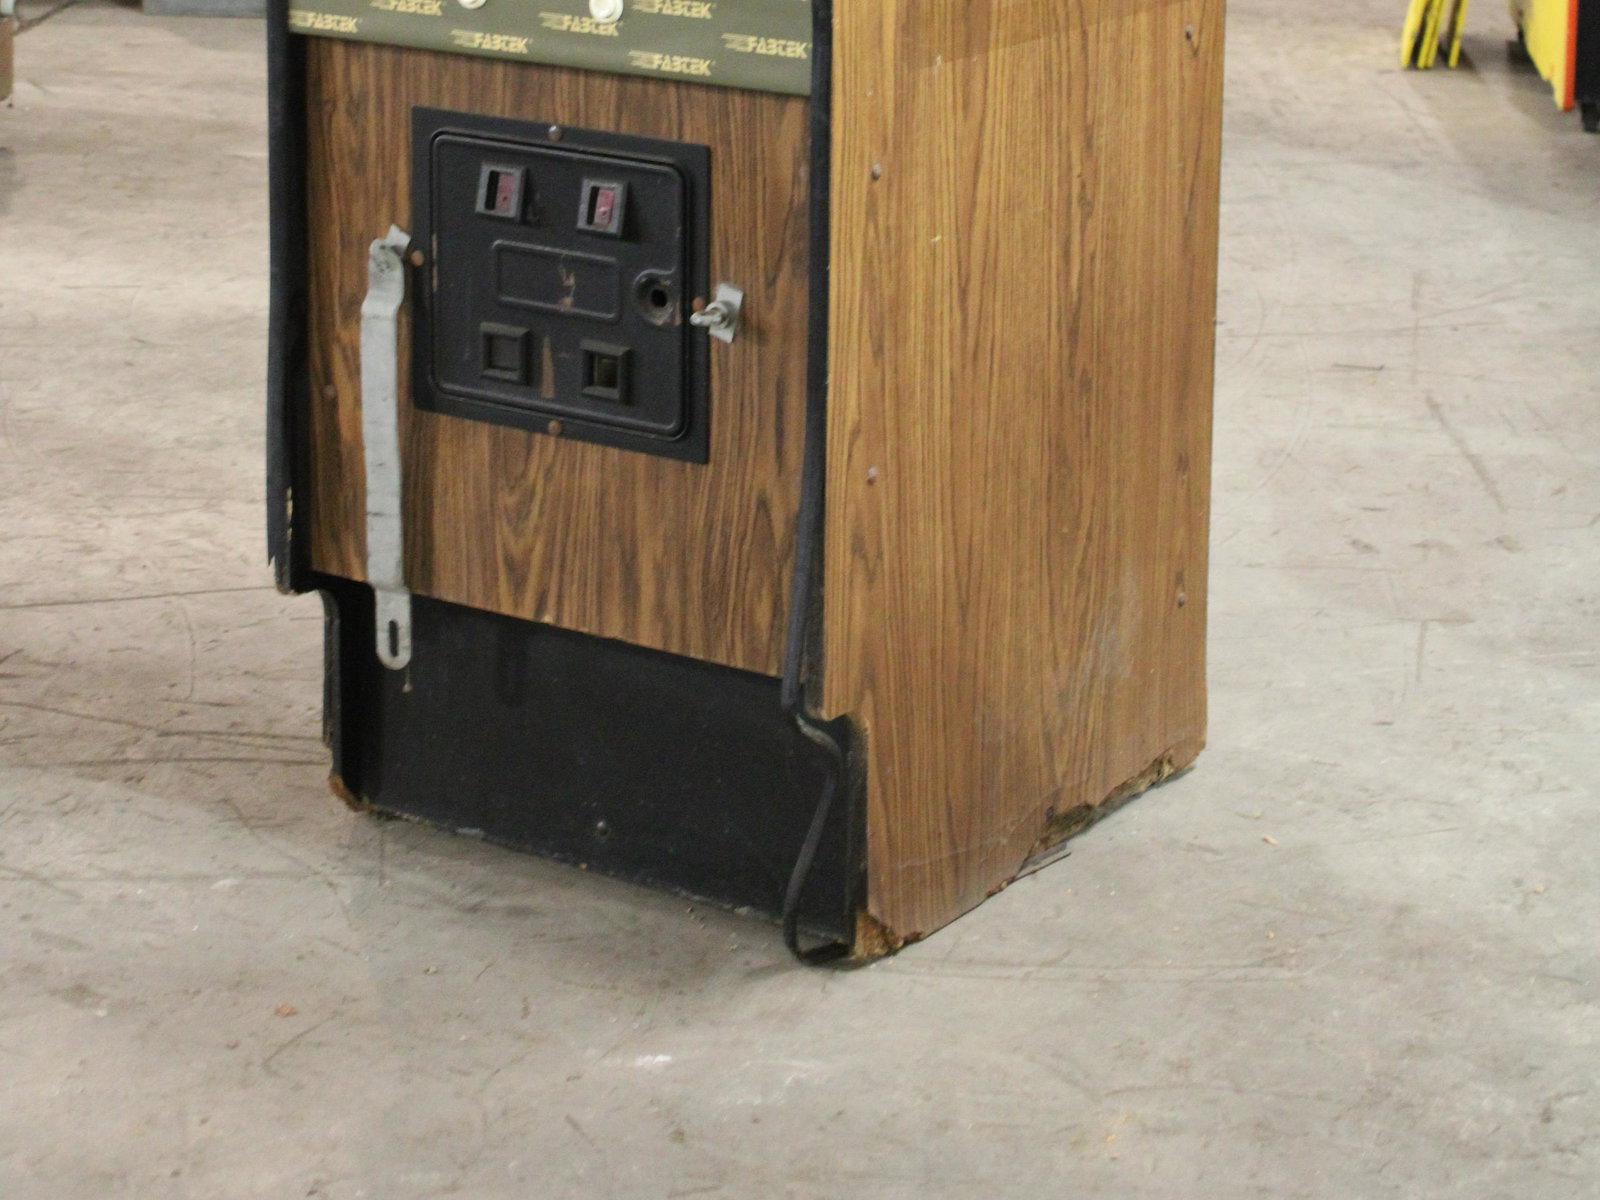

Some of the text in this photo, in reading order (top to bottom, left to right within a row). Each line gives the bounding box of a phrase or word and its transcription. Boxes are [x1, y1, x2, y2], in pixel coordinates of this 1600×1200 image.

[474, 30, 529, 54] FABTEK
[749, 33, 809, 60] FABTEK
[653, 53, 713, 76] FABTEK
